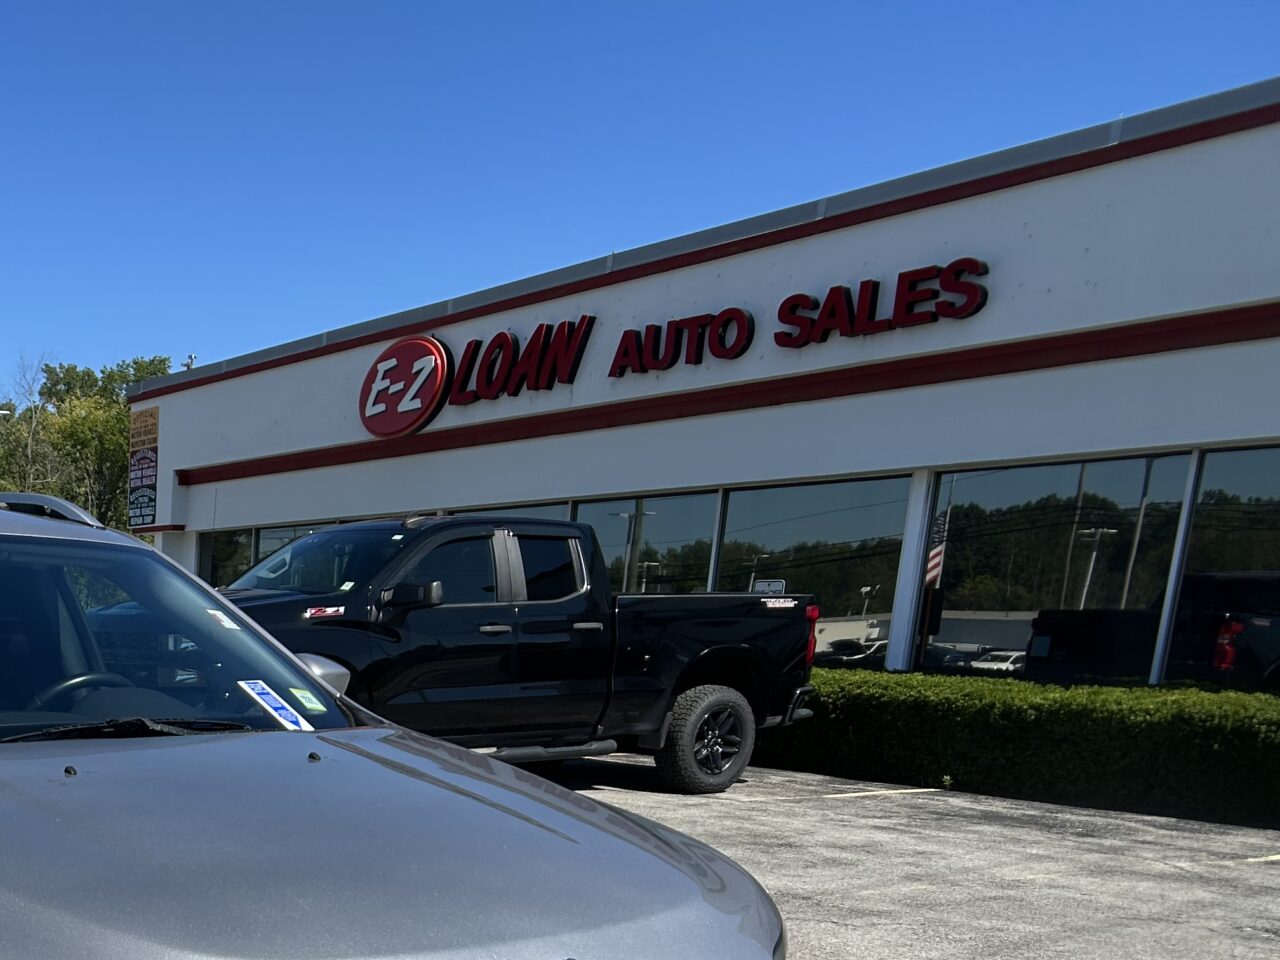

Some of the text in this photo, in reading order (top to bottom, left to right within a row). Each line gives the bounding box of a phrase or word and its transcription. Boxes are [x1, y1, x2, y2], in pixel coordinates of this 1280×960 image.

[365, 256, 988, 418] E-Z LOAN AUTO SALES
